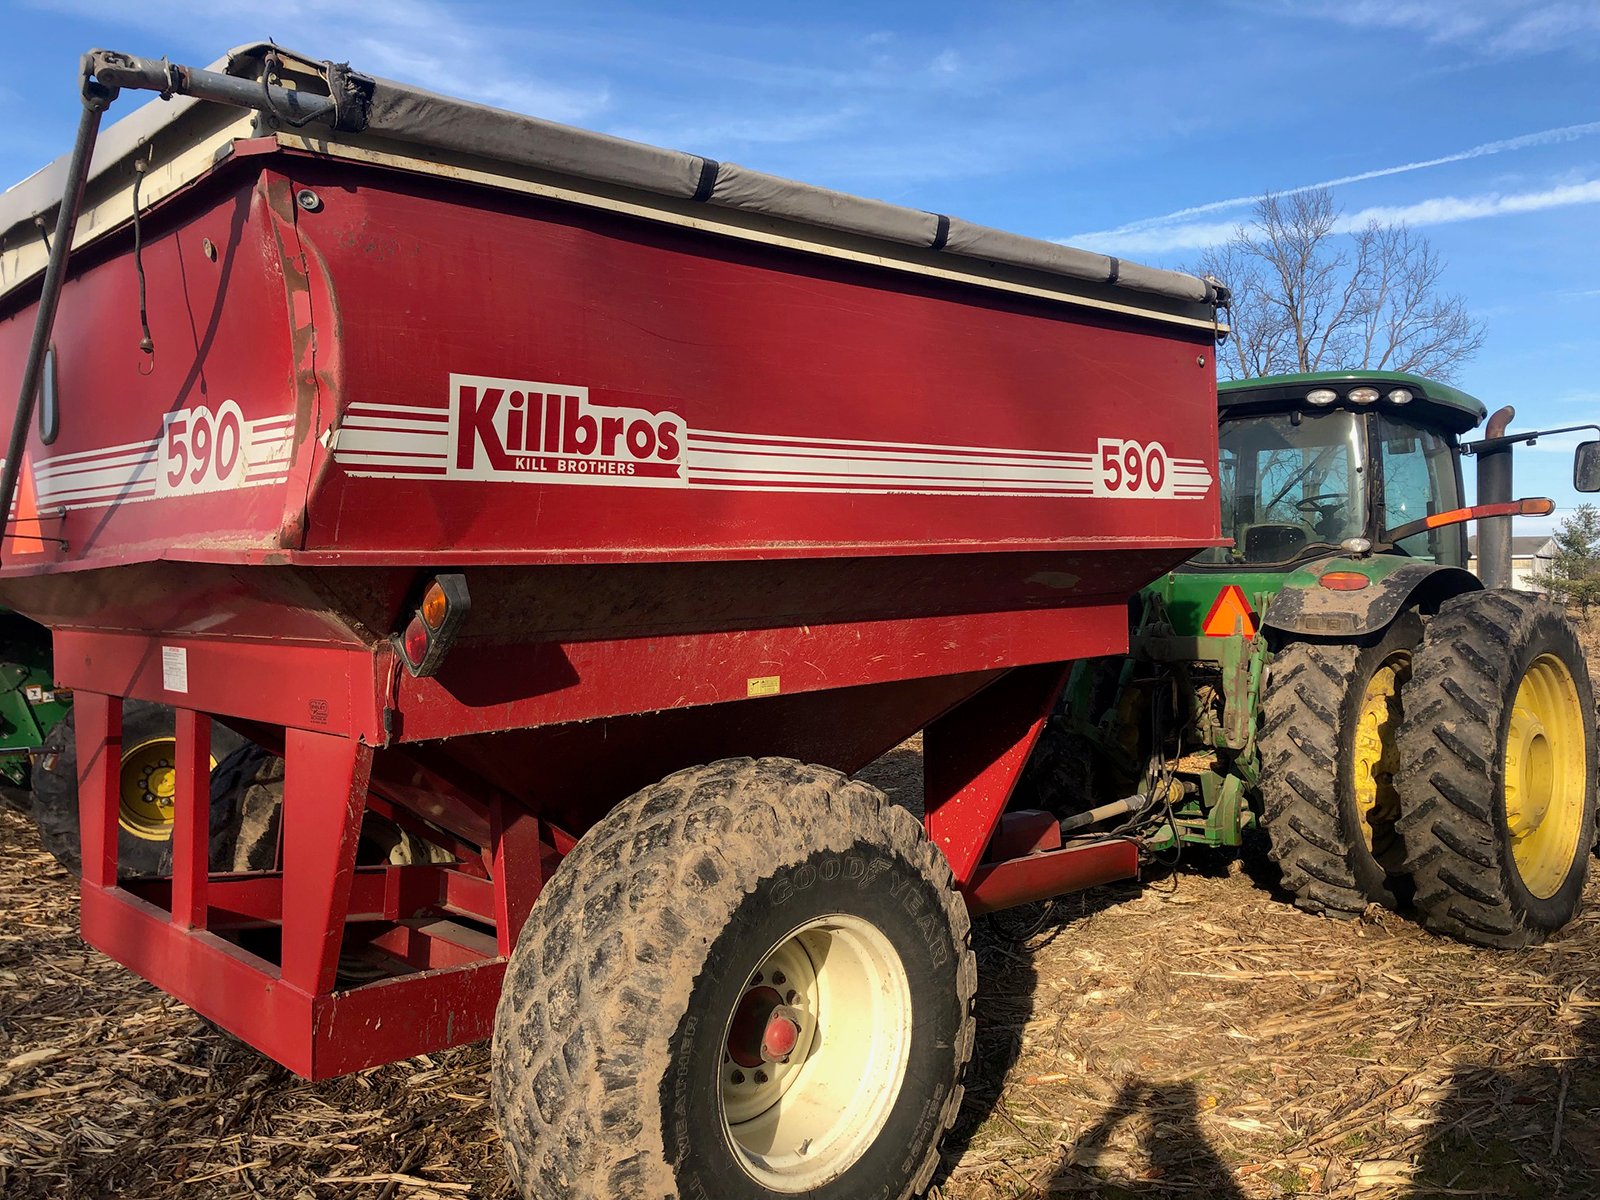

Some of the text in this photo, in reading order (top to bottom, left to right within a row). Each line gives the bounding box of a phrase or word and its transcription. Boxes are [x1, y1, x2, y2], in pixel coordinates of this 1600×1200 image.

[167, 410, 241, 488] 590
[456, 385, 681, 470] Killbros
[515, 457, 636, 475] KILL BROTHERS
[1102, 445, 1165, 492] 590
[769, 857, 948, 970] GOODYEAR
